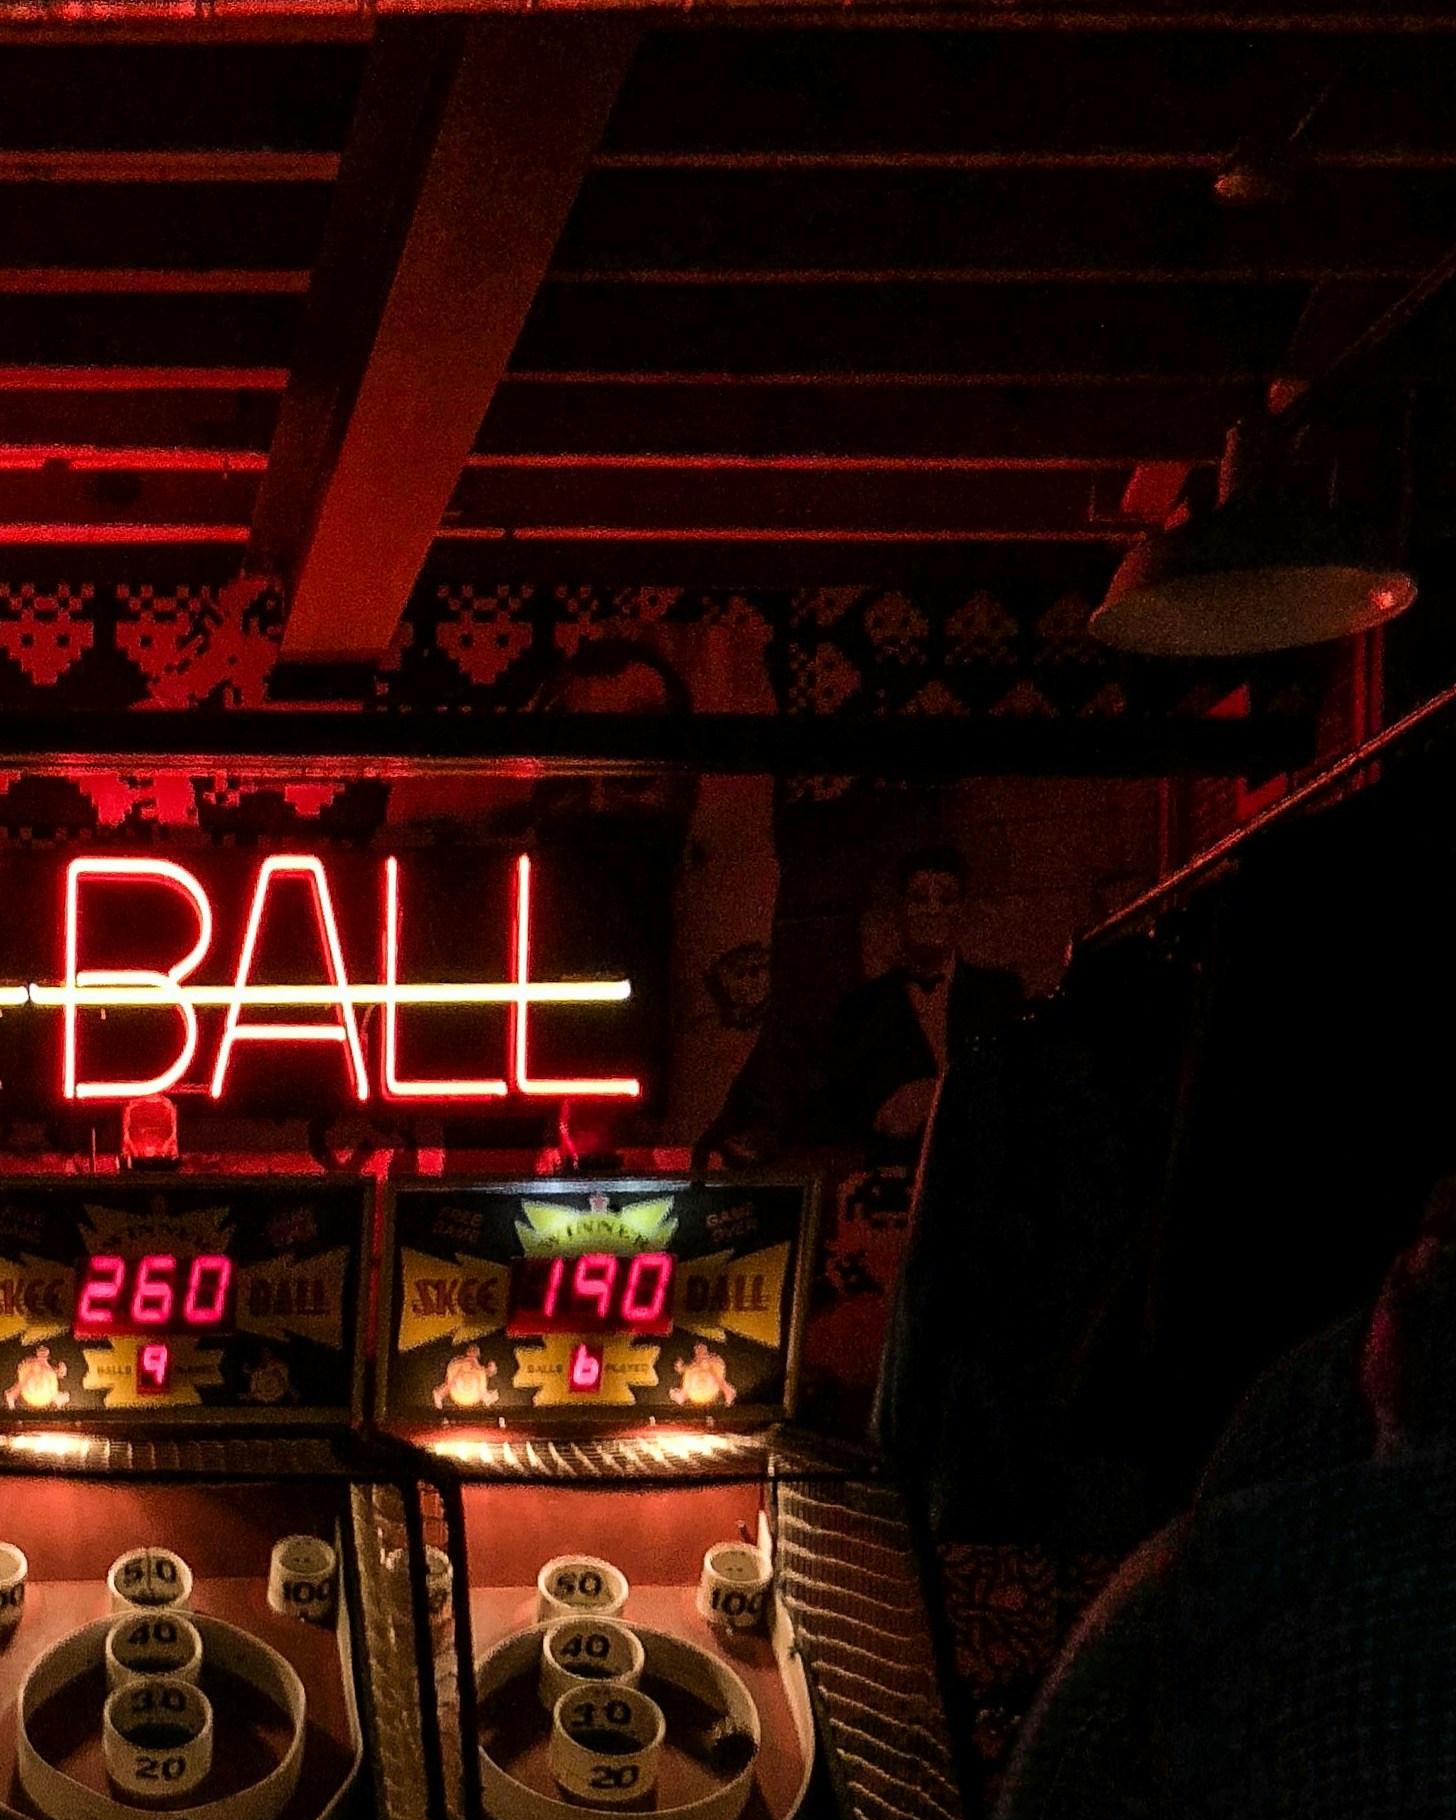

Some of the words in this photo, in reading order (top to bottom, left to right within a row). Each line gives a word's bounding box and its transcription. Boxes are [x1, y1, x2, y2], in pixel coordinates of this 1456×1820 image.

[63, 854, 642, 1103] BALL
[78, 1254, 232, 1324] 260
[545, 1253, 673, 1321] 190
[123, 1561, 177, 1586] 50
[555, 1571, 603, 1598] 50
[128, 1622, 178, 1645] 40
[561, 1633, 610, 1660] 40
[135, 1756, 187, 1782] 20
[588, 1764, 639, 1790] 20
